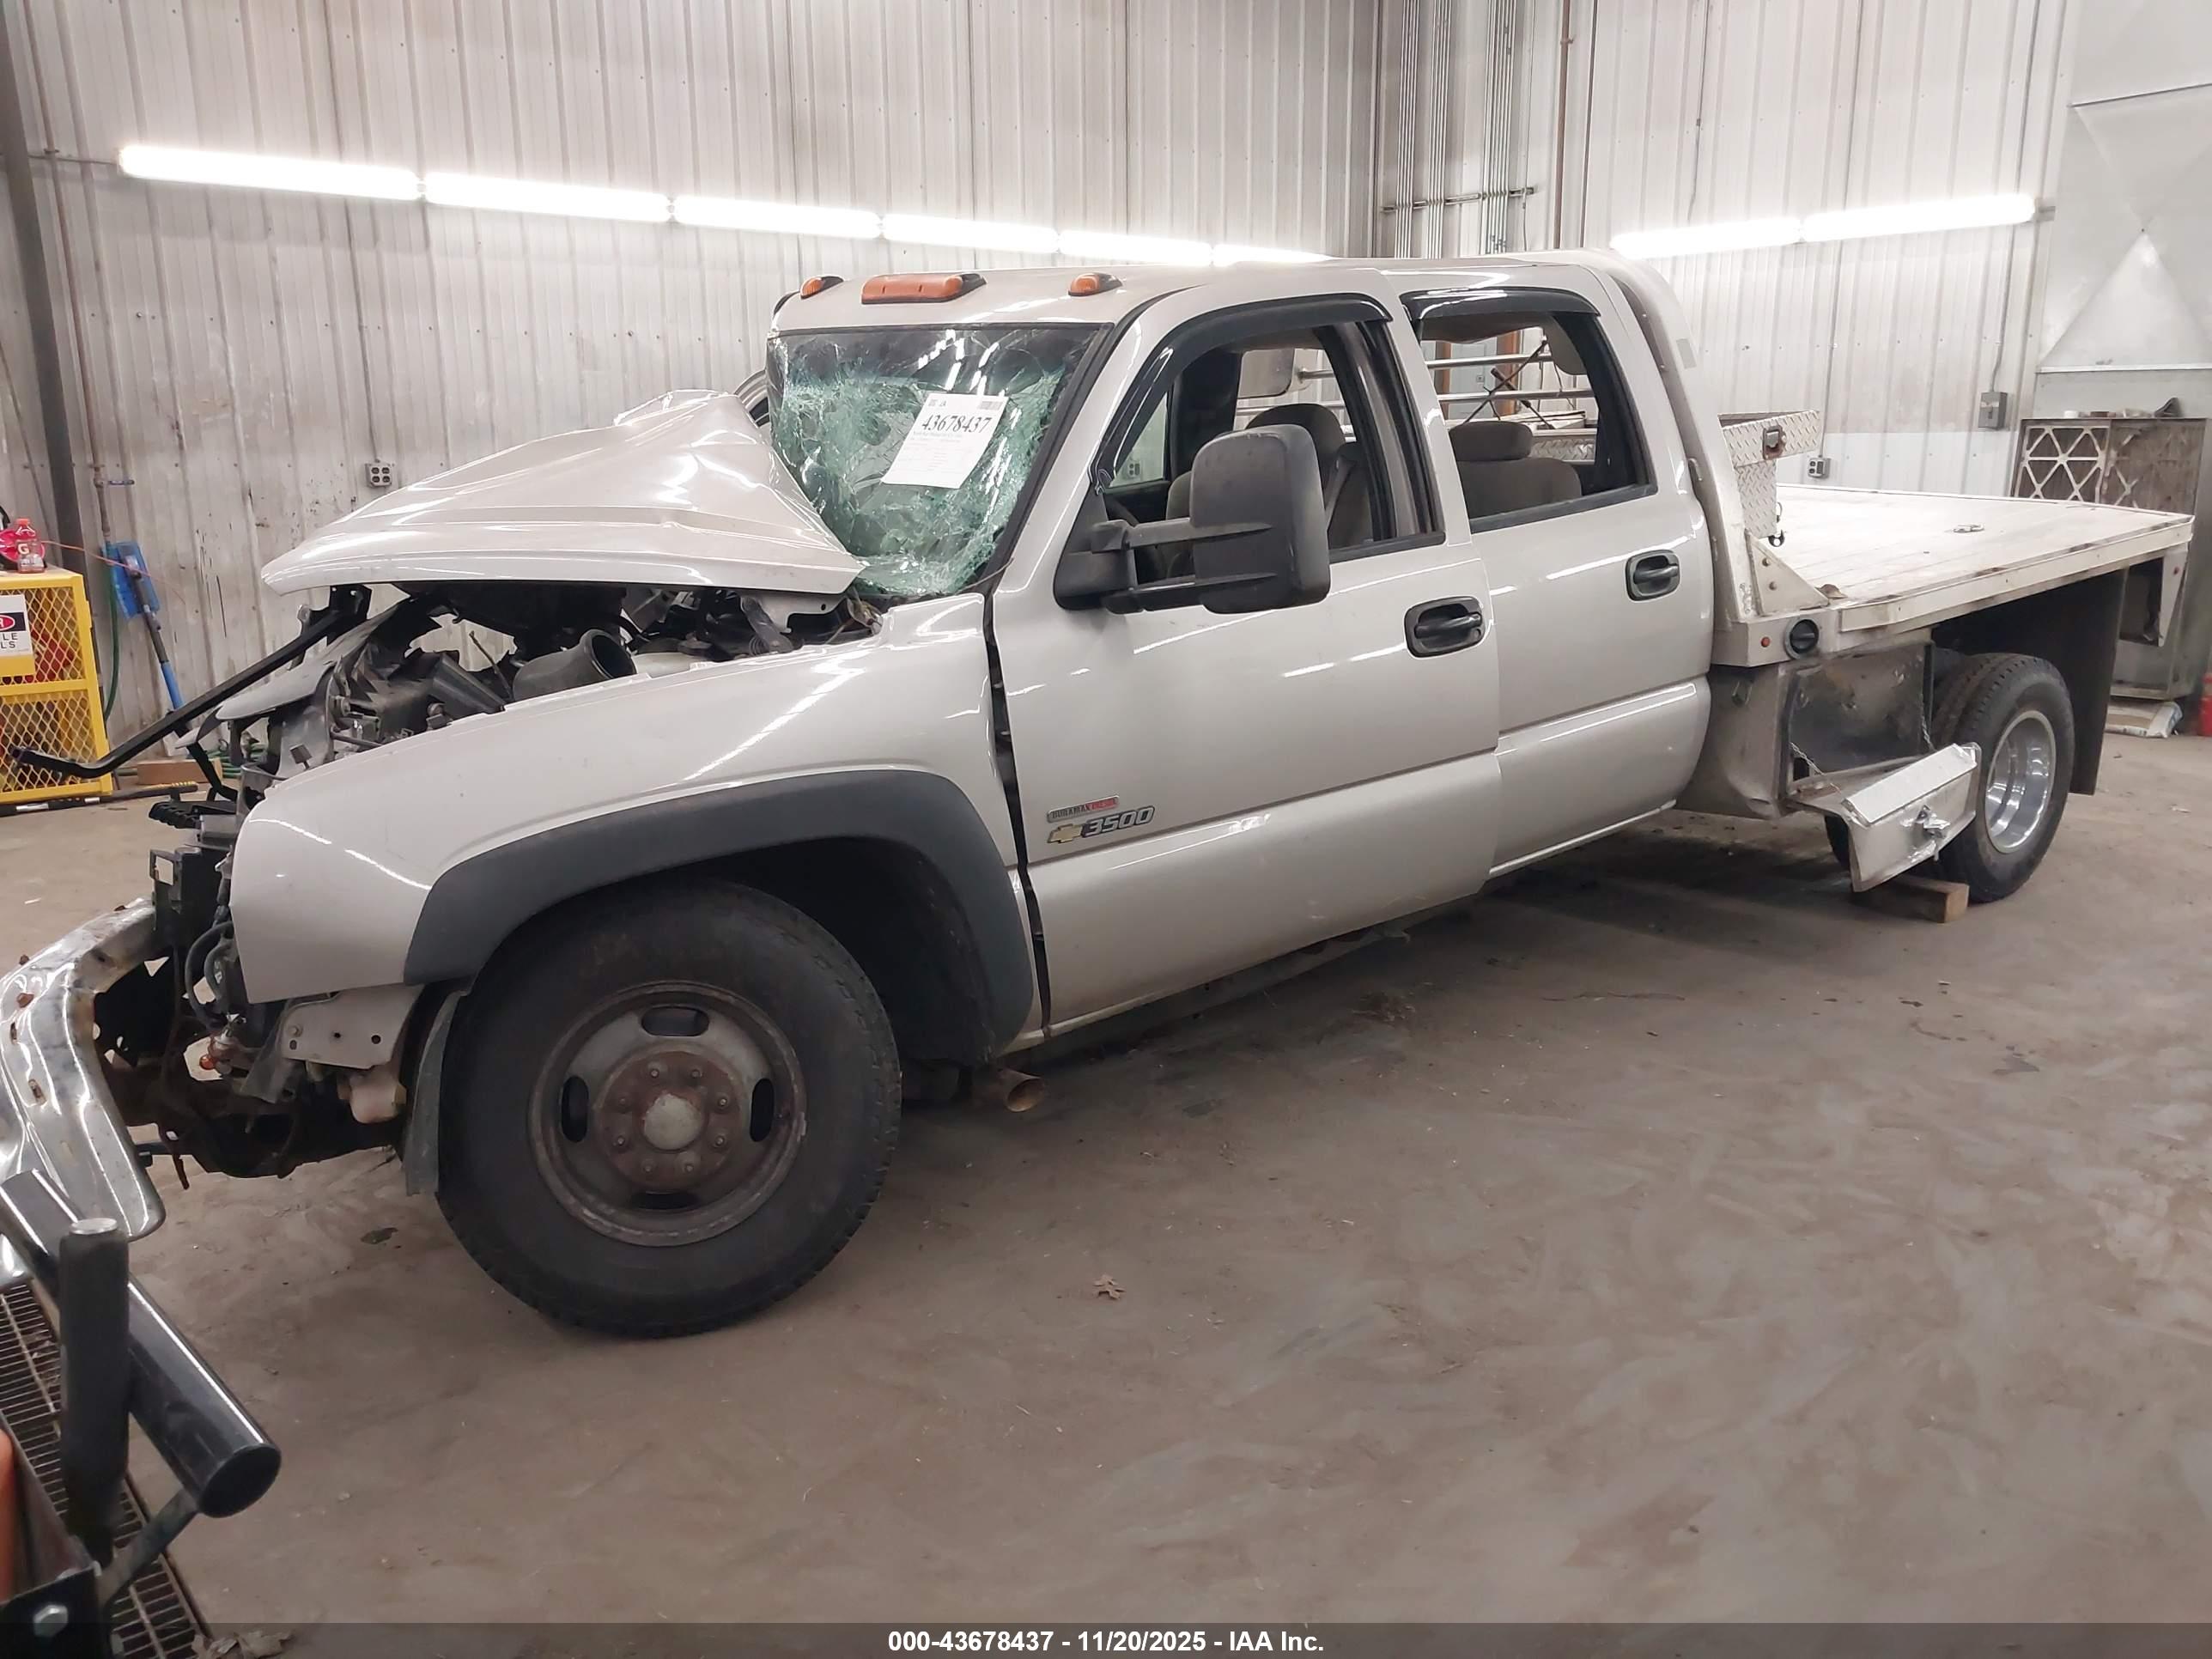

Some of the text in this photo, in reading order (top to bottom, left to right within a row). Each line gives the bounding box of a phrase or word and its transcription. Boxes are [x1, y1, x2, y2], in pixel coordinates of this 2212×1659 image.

[921, 414, 993, 434] 43678437
[17, 543, 30, 556] G
[1084, 806, 1155, 837] 3500
